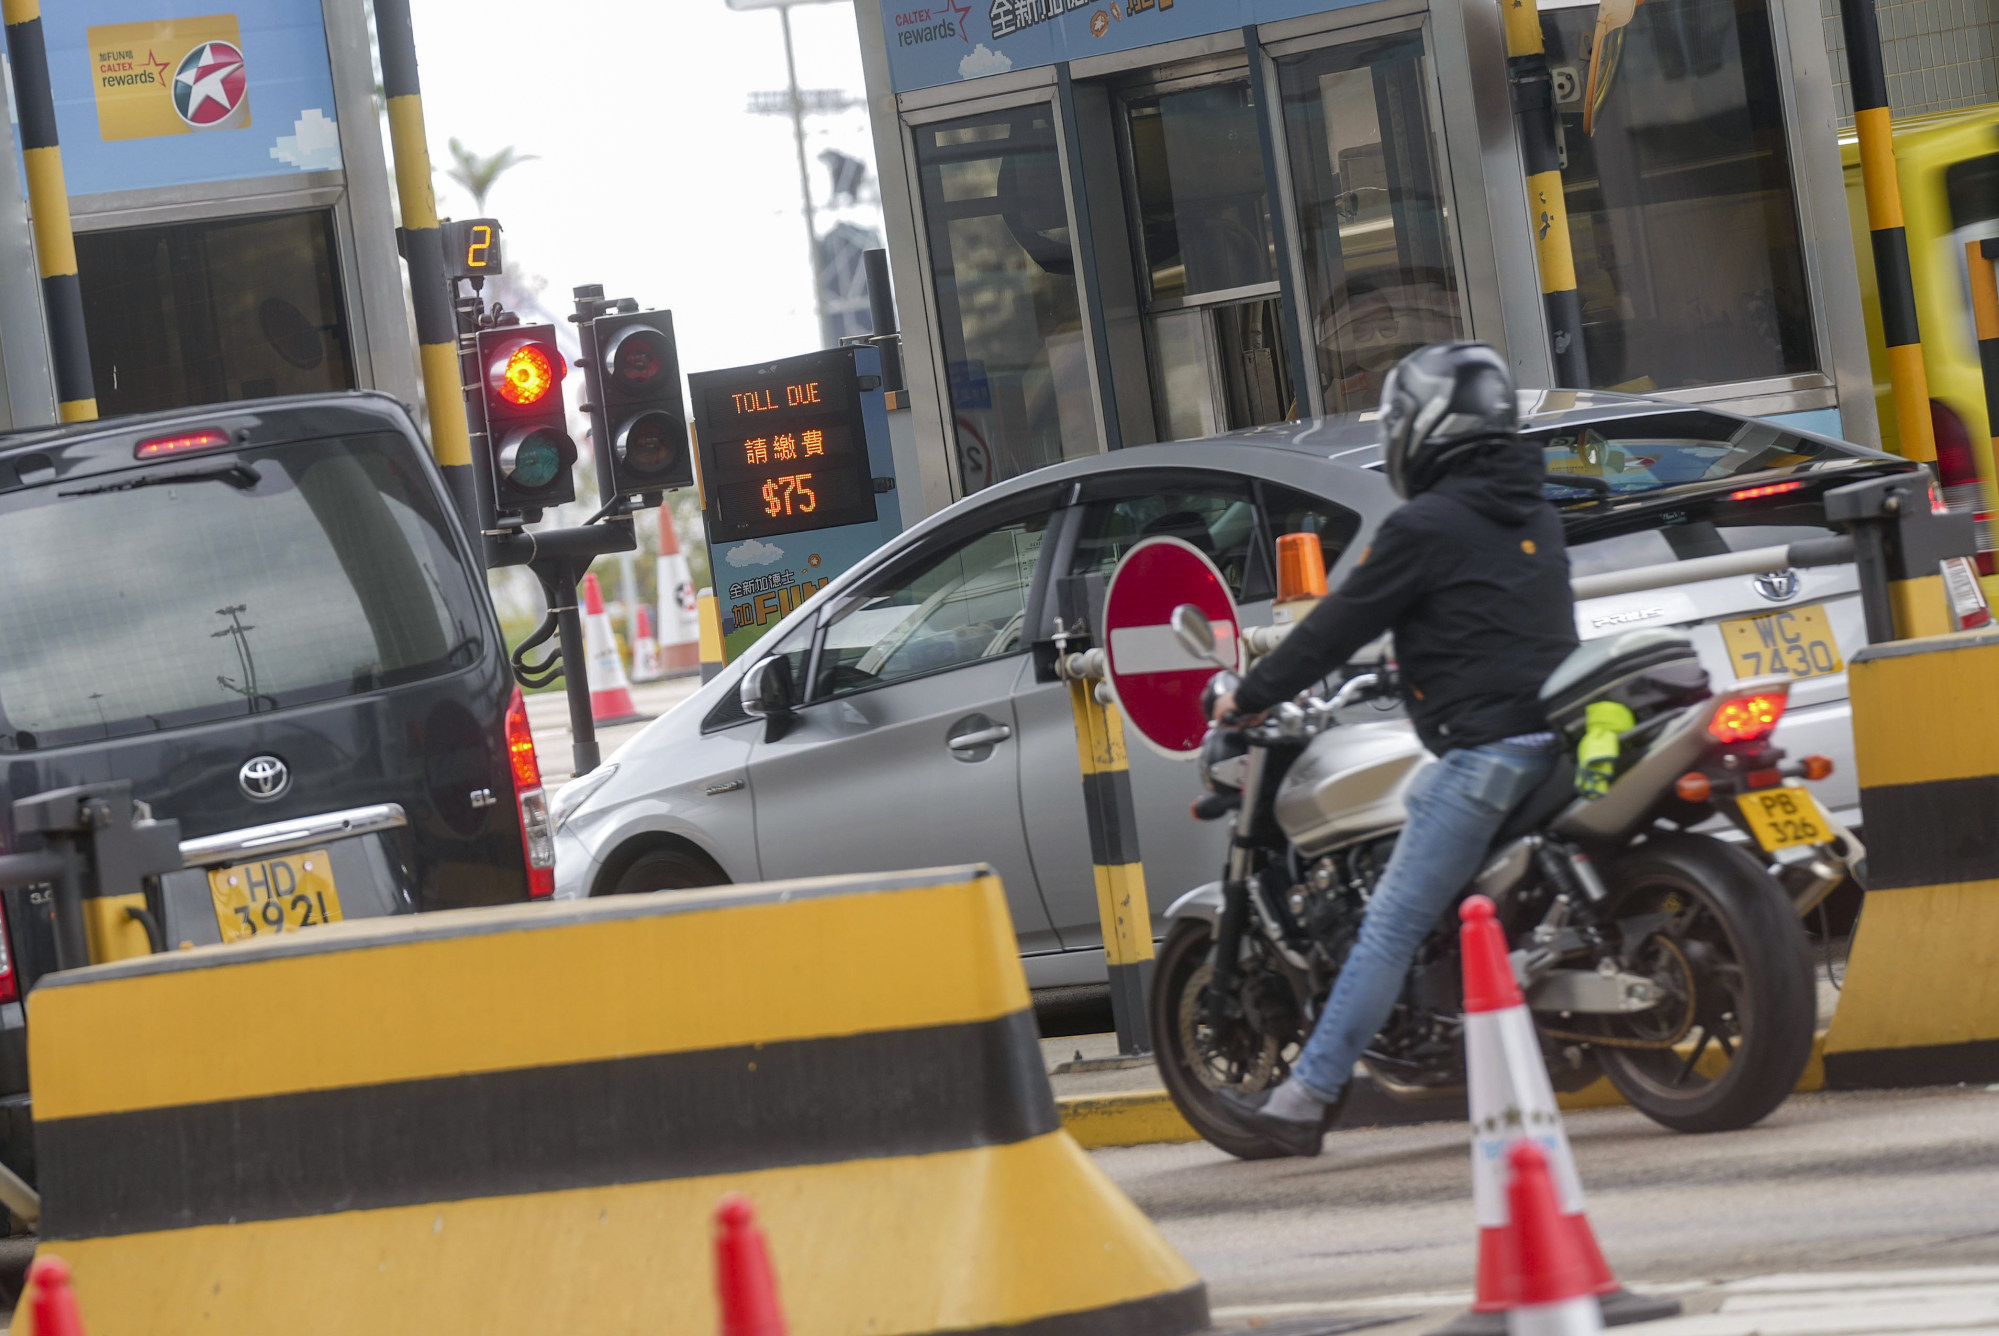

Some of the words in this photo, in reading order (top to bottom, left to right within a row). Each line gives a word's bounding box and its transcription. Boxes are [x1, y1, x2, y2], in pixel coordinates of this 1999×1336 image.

[895, 8, 932, 27] CALTEX
[898, 18, 956, 47] rewards
[100, 62, 133, 73] CALTEX
[102, 69, 155, 87] rewards
[467, 225, 491, 267] 2
[731, 389, 779, 414] TOLL
[786, 382, 821, 406] DUE
[744, 429, 824, 465] 請繳費
[762, 473, 816, 518] $75
[729, 569, 795, 600] 全新加德士
[1592, 608, 1664, 628] PRIUS
[1752, 611, 1802, 649] WC
[1741, 640, 1834, 677] 7430
[1760, 793, 1798, 818] PB
[1767, 816, 1818, 844] 326
[245, 860, 297, 903] HD
[234, 890, 329, 937] 3921
